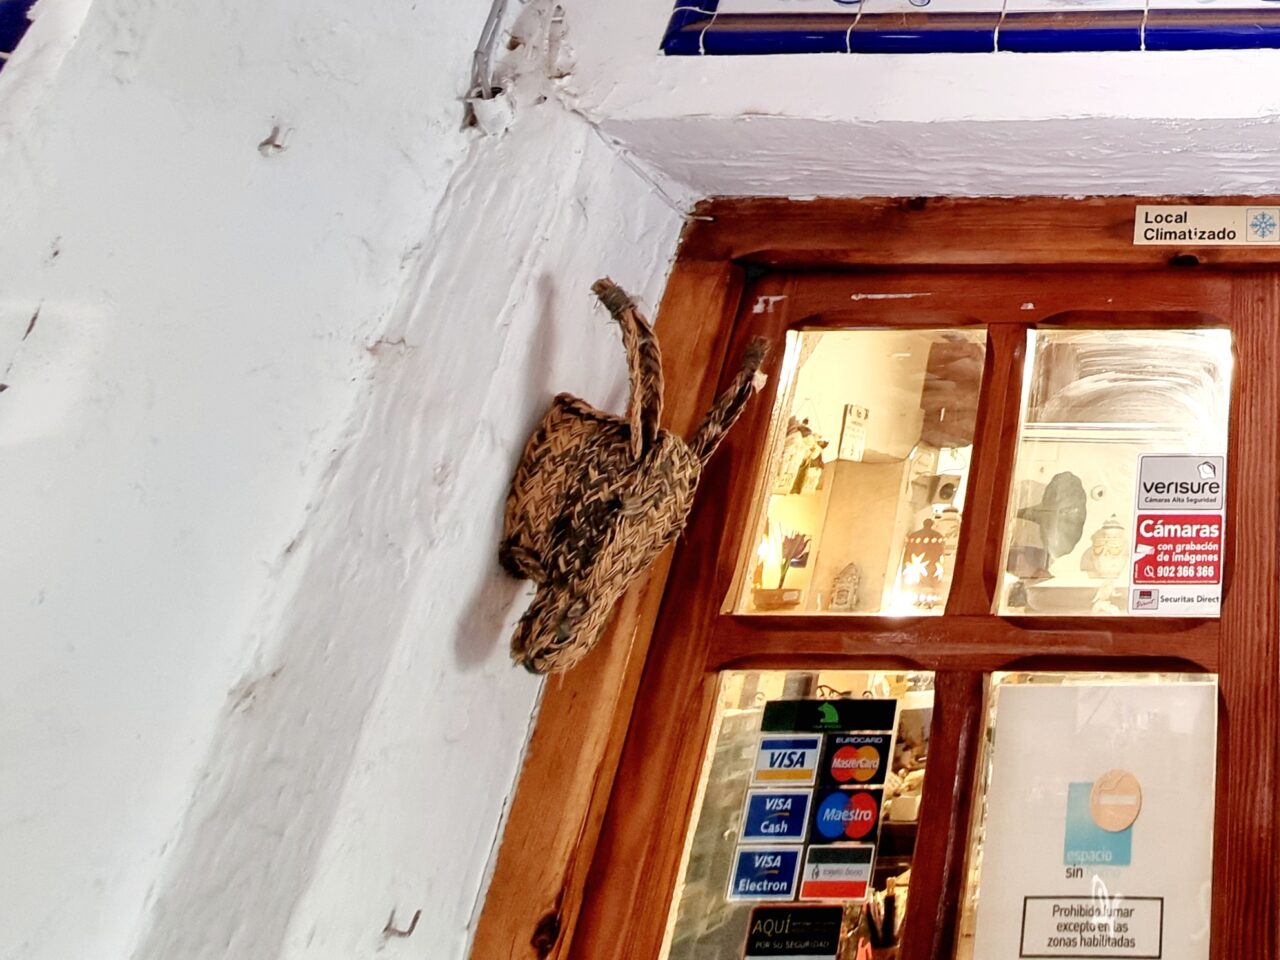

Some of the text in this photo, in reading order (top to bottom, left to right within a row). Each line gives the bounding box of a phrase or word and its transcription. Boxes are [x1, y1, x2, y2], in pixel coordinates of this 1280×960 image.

[1145, 211, 1188, 224] Local
[1144, 227, 1237, 241] Climatizado
[1143, 481, 1220, 494] verisure
[1186, 496, 1217, 504] Seguridad
[1139, 519, 1220, 538] Cámaras
[1175, 541, 1219, 552] grabación
[1156, 551, 1219, 563] de imágenes
[1157, 566, 1214, 578] 902 366 366
[1160, 595, 1220, 604] Securitas Direct
[768, 751, 806, 769] VISA
[832, 757, 880, 768] MasterCard
[765, 798, 792, 810] VISA
[823, 807, 872, 822] Maestro
[760, 821, 788, 833] Cash
[754, 855, 782, 868] VISA
[1067, 849, 1112, 864] espacio
[1065, 864, 1083, 878] sin
[738, 878, 788, 891] Electron
[1052, 904, 1101, 918] Prohibido
[752, 913, 792, 936] AQUÍ
[1056, 920, 1128, 935] excepto en las
[1047, 933, 1136, 948] zonas habilitadas
